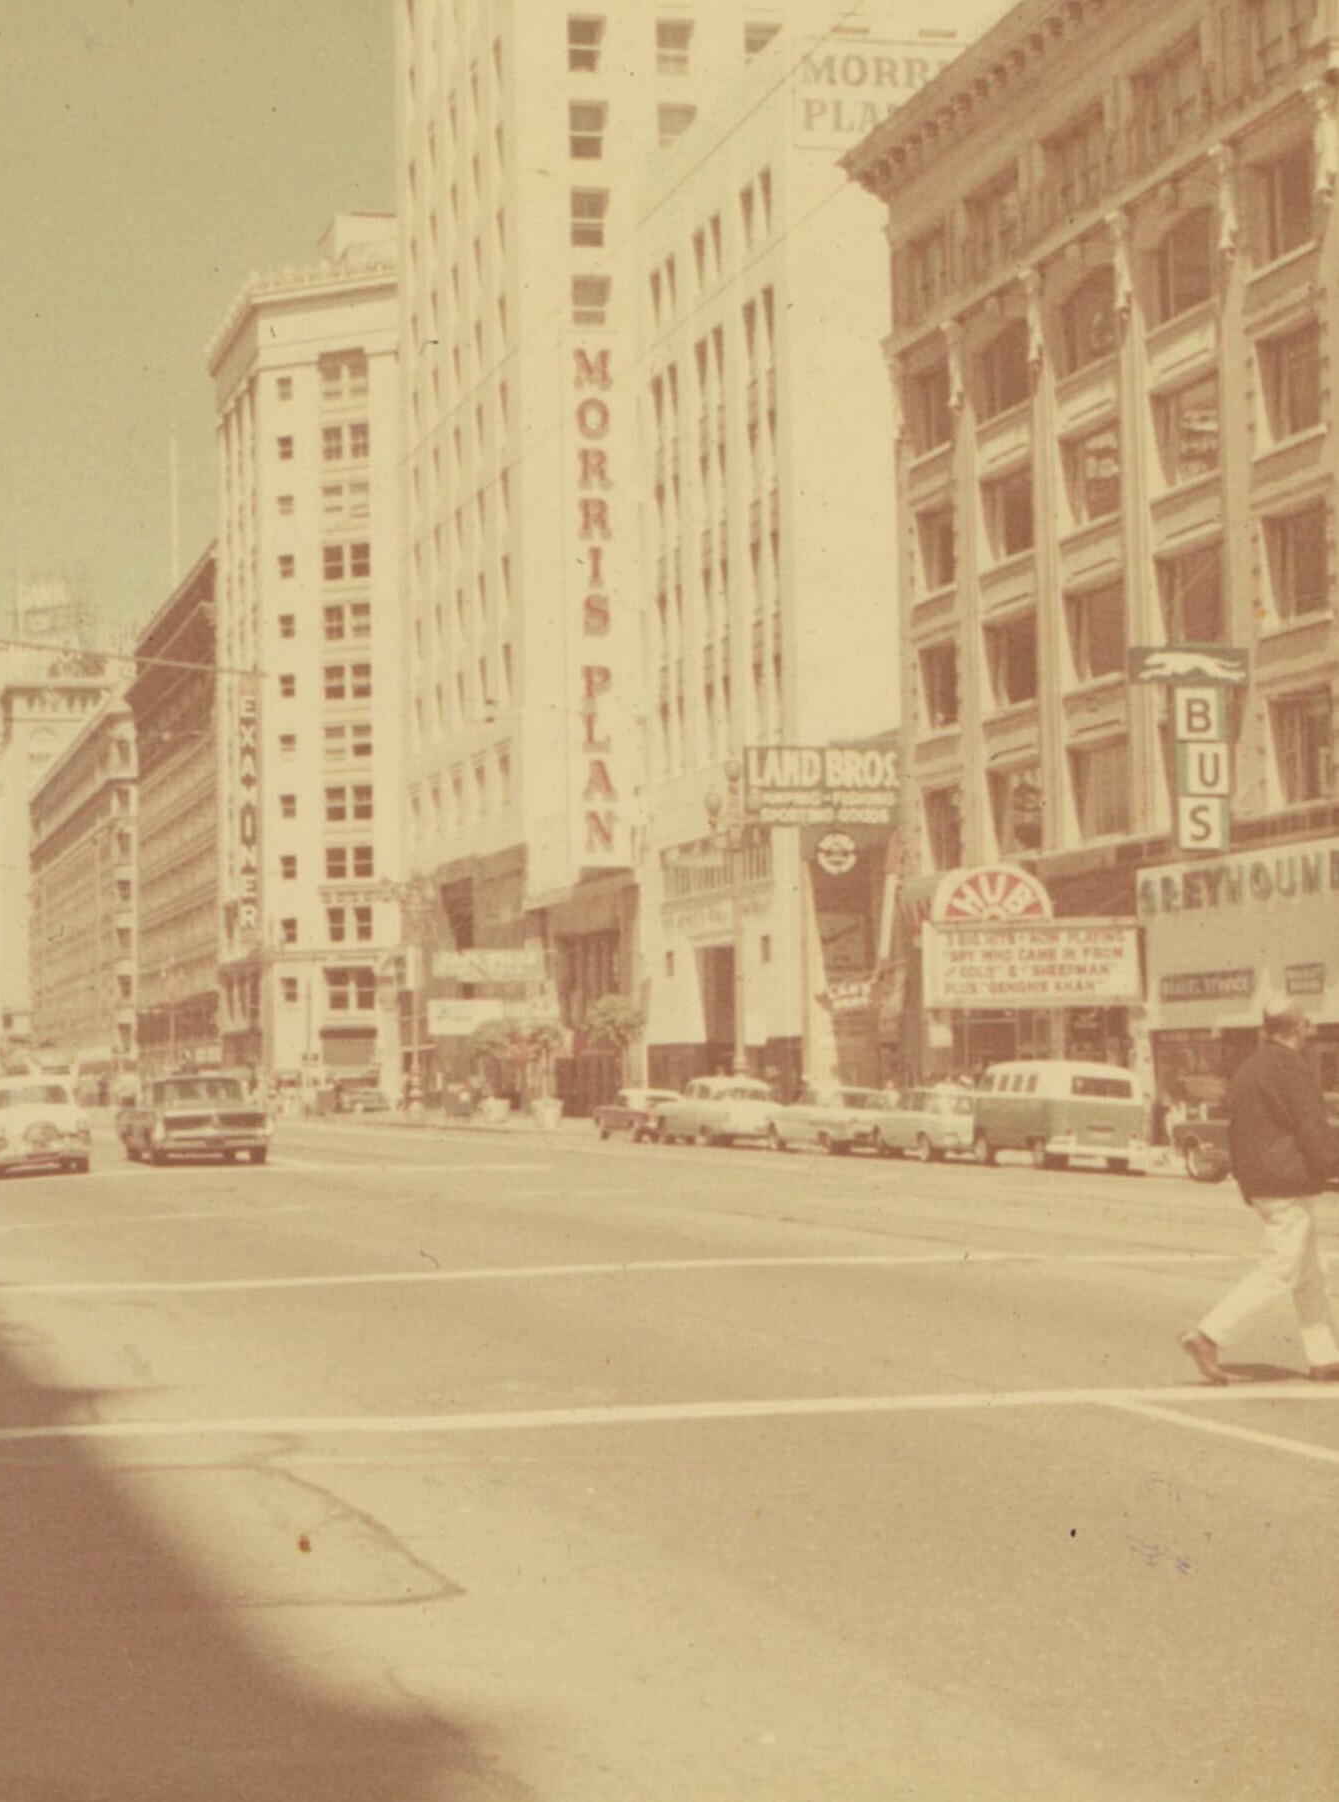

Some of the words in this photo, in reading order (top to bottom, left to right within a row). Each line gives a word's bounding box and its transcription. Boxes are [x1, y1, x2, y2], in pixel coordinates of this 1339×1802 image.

[800, 54, 947, 88] MORR
[802, 99, 899, 133] PLA
[573, 348, 613, 637] MORRIS
[581, 664, 617, 853] PLAN
[748, 749, 822, 788] LAND
[825, 749, 900, 788] BROS
[1185, 697, 1221, 843] BUS
[240, 695, 257, 931] EXAMINER
[951, 872, 1035, 915] HUB
[1018, 947, 1057, 961] CAME
[1083, 946, 1124, 959] FROM
